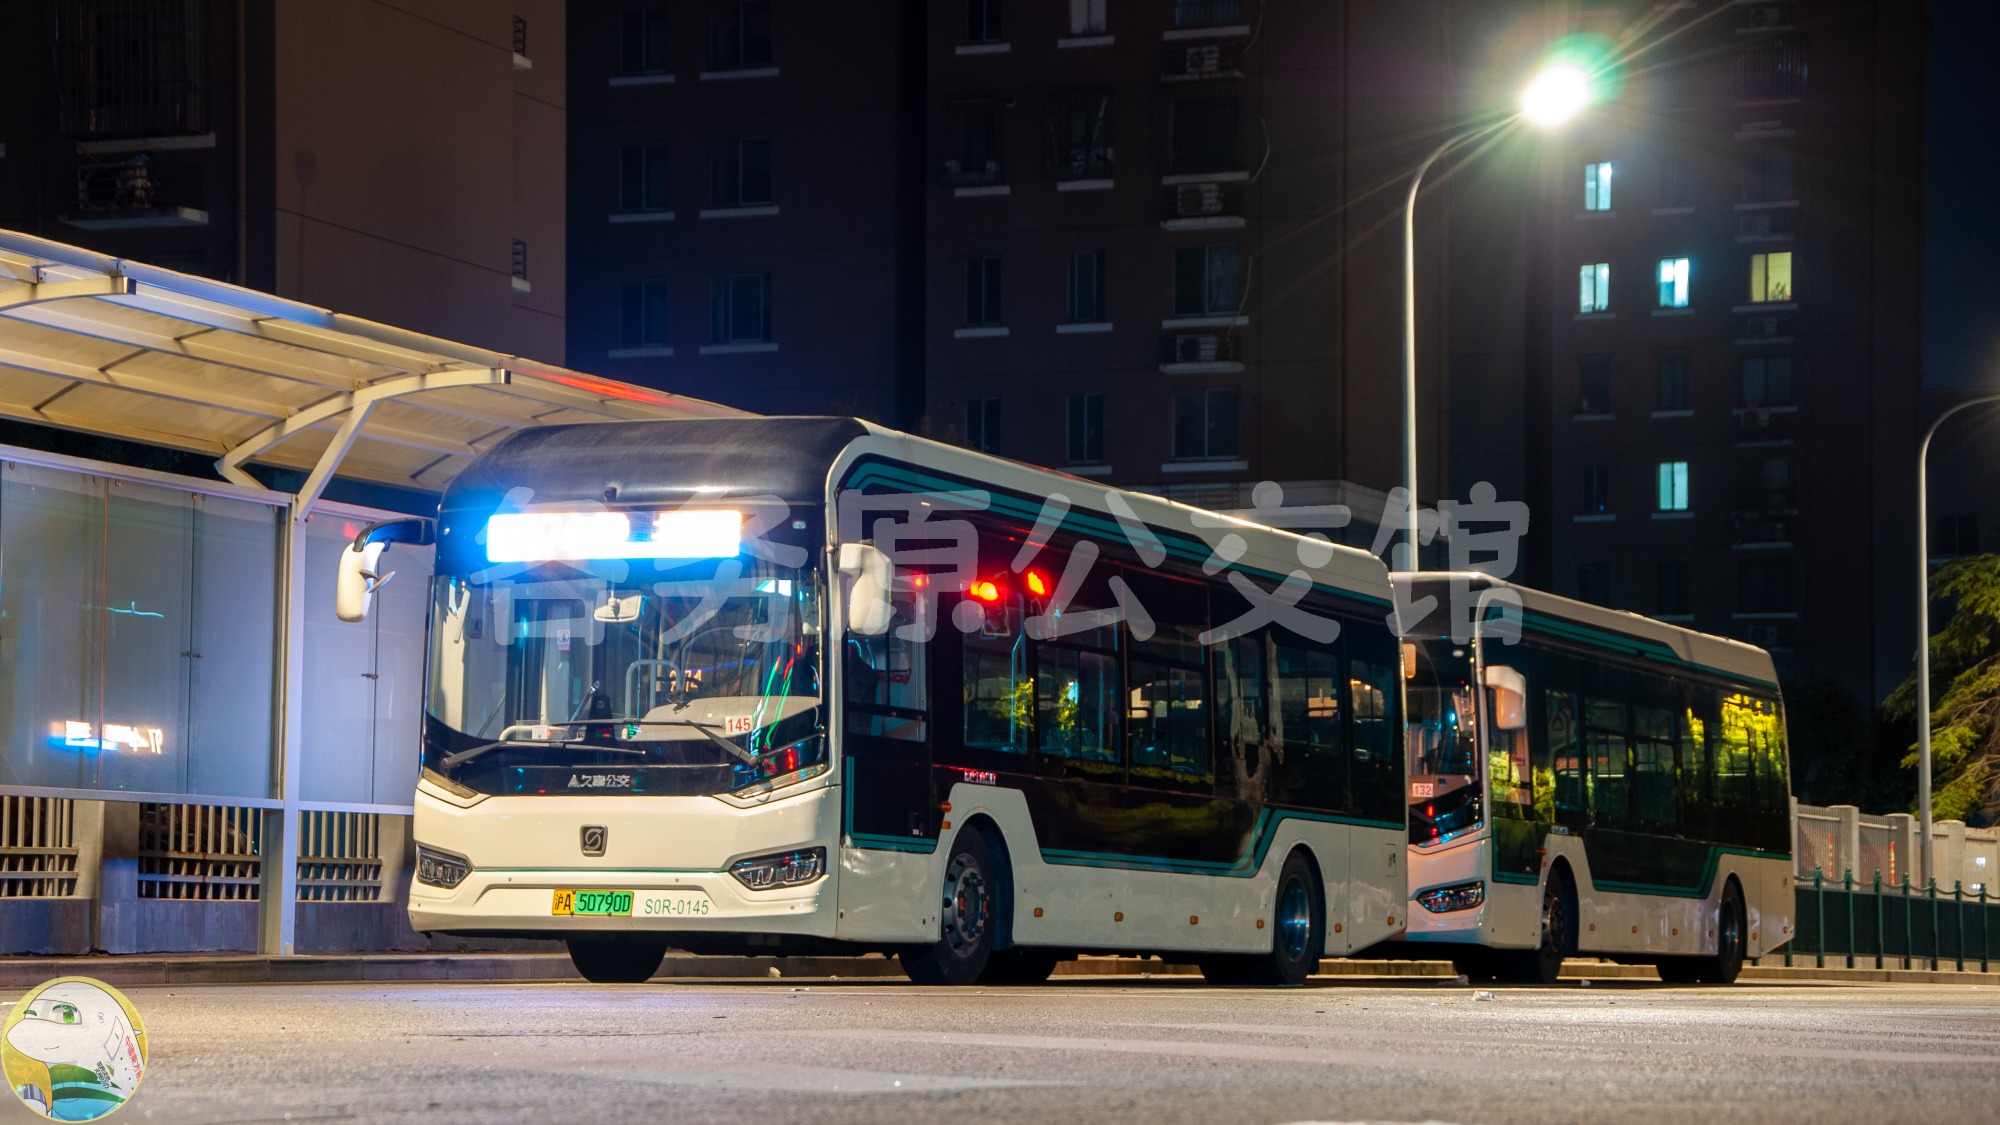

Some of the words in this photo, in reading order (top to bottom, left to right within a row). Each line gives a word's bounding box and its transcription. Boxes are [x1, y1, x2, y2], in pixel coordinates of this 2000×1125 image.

[728, 718, 751, 733] 145
[1415, 785, 1432, 796] 132
[578, 894, 631, 913] 50790D
